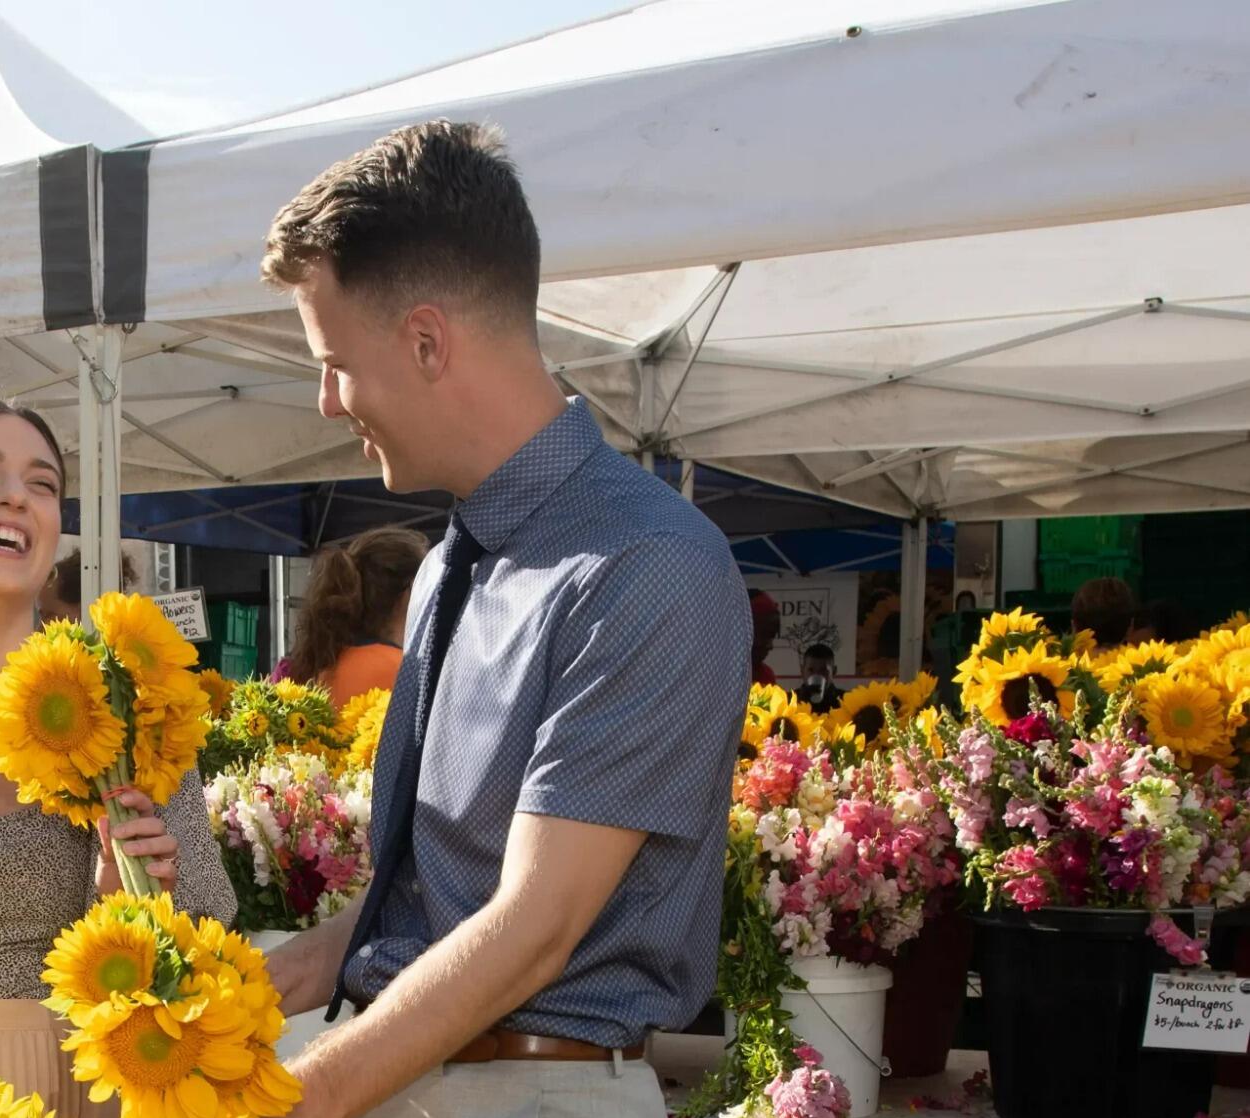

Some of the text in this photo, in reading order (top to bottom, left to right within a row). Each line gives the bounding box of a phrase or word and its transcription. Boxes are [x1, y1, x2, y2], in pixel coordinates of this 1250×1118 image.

[154, 595, 189, 606] ORGANIC
[162, 604, 196, 618] flowers
[782, 600, 824, 616] DEN
[183, 627, 200, 637] $12
[1176, 981, 1237, 993] ORGANIC
[1156, 990, 1233, 1019] Snapdragons
